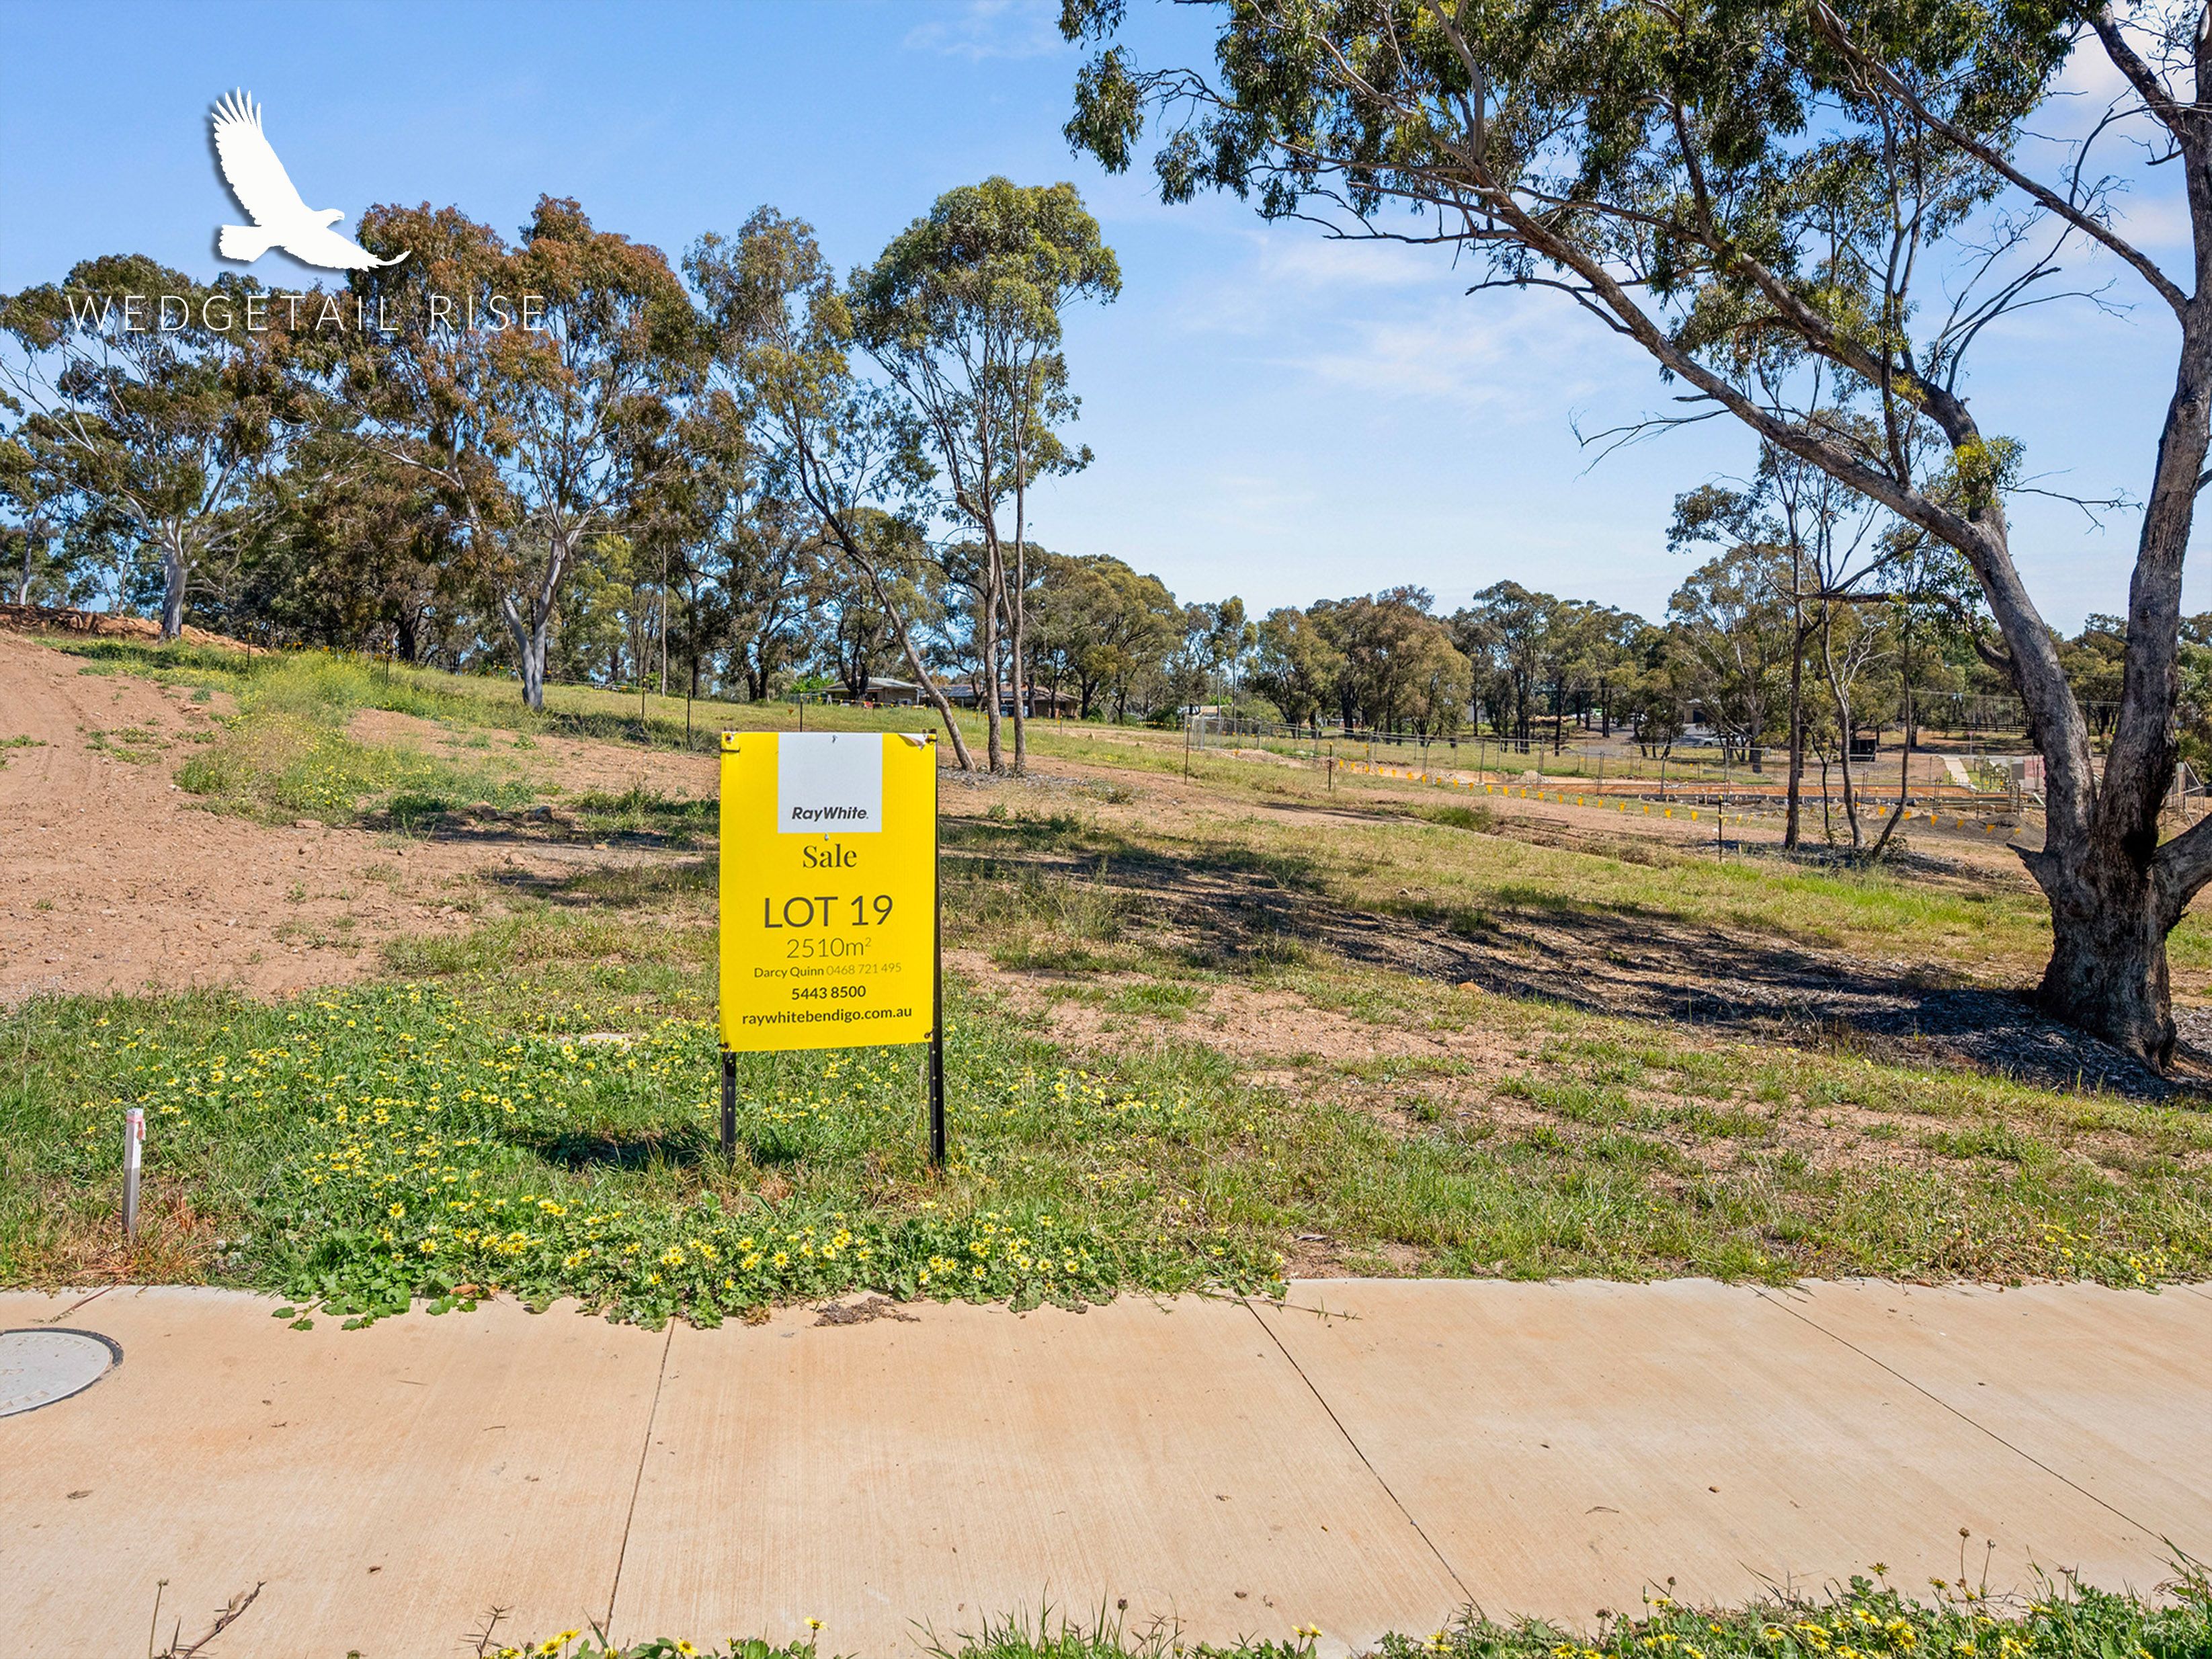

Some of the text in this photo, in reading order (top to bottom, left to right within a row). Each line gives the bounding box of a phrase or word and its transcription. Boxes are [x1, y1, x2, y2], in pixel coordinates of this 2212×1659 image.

[803, 844, 858, 868] Sale
[764, 895, 893, 928] LOT 19
[754, 962, 902, 979] Darcy Quinn 0468 721 495
[791, 985, 866, 1000] 5443 8500
[742, 1007, 912, 1026] raywhitebendigo.com.au
